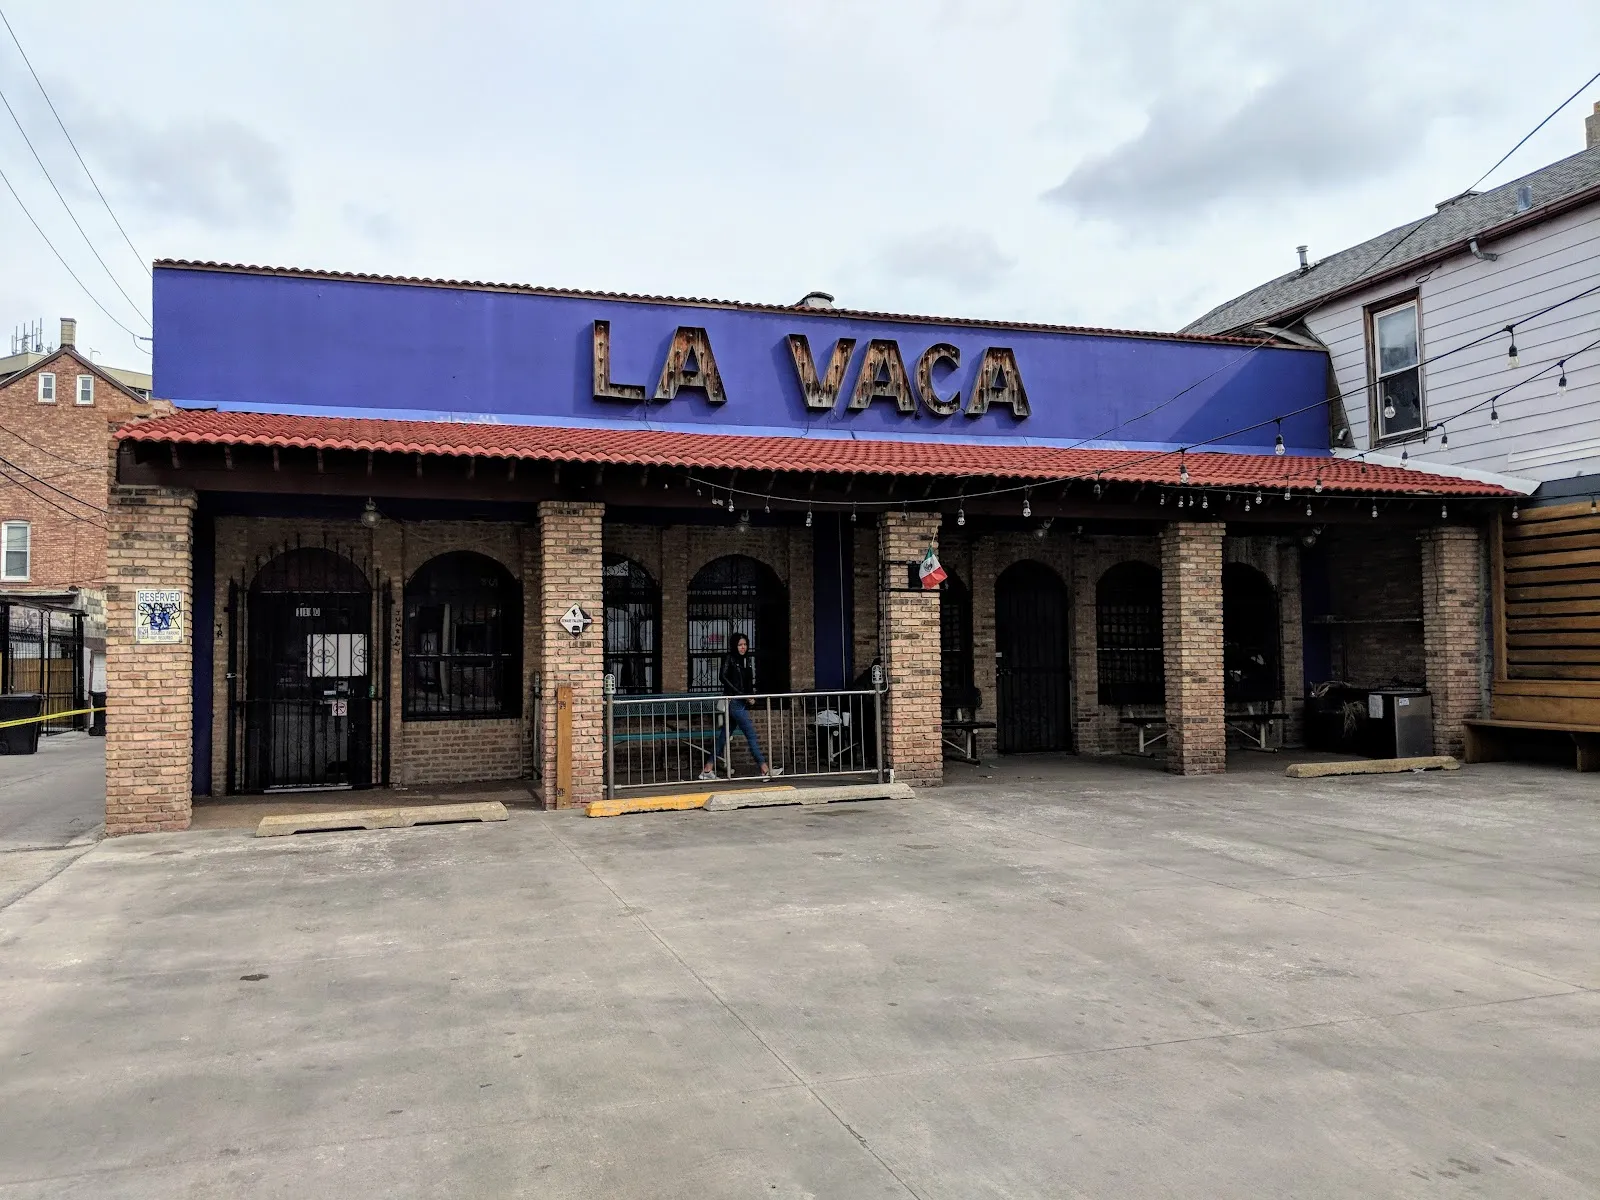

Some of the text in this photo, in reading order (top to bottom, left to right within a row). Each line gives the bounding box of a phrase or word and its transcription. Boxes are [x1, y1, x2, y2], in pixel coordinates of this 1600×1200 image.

[593, 319, 1031, 418] LA VACA
[139, 593, 180, 601] RESERVED
